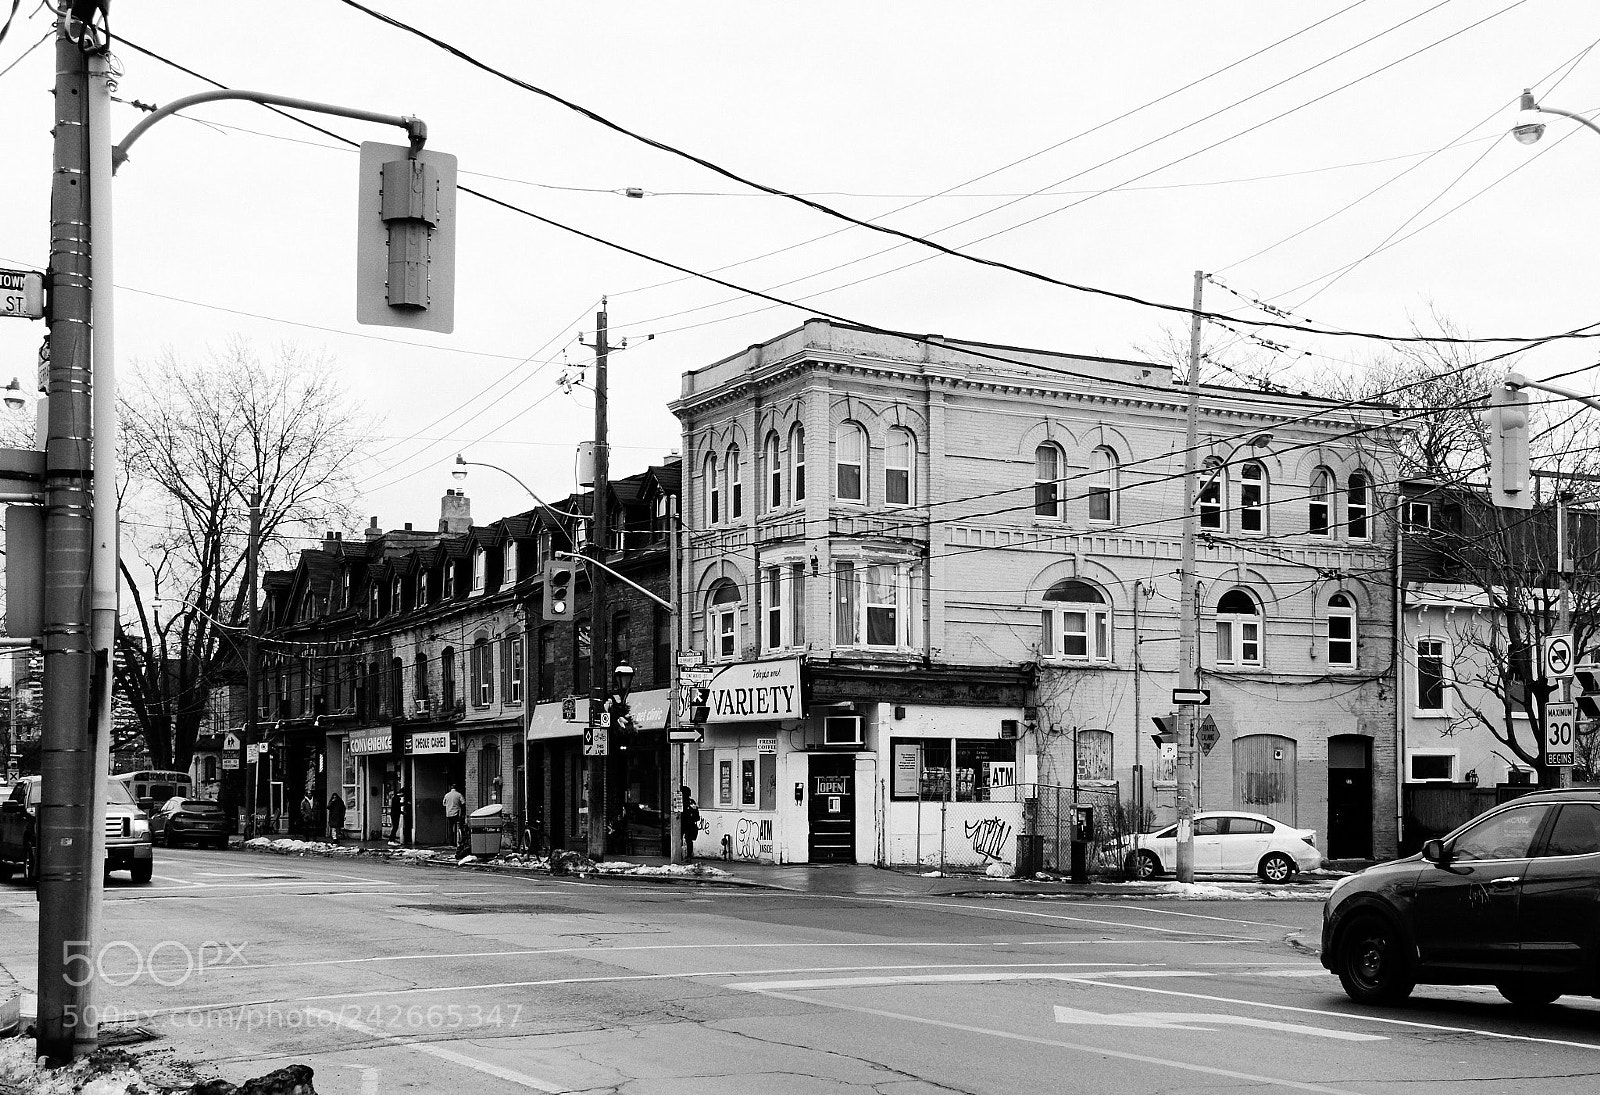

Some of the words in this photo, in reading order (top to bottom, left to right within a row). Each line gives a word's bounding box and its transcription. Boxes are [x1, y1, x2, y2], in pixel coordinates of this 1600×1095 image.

[712, 685, 794, 716] VARIETY
[1548, 708, 1572, 717] MAXIMUM
[1549, 722, 1571, 745] 30
[1549, 754, 1572, 764] BEGINS
[992, 767, 1013, 785] ATM
[820, 782, 843, 793] OPEN
[760, 820, 772, 840] ATM
